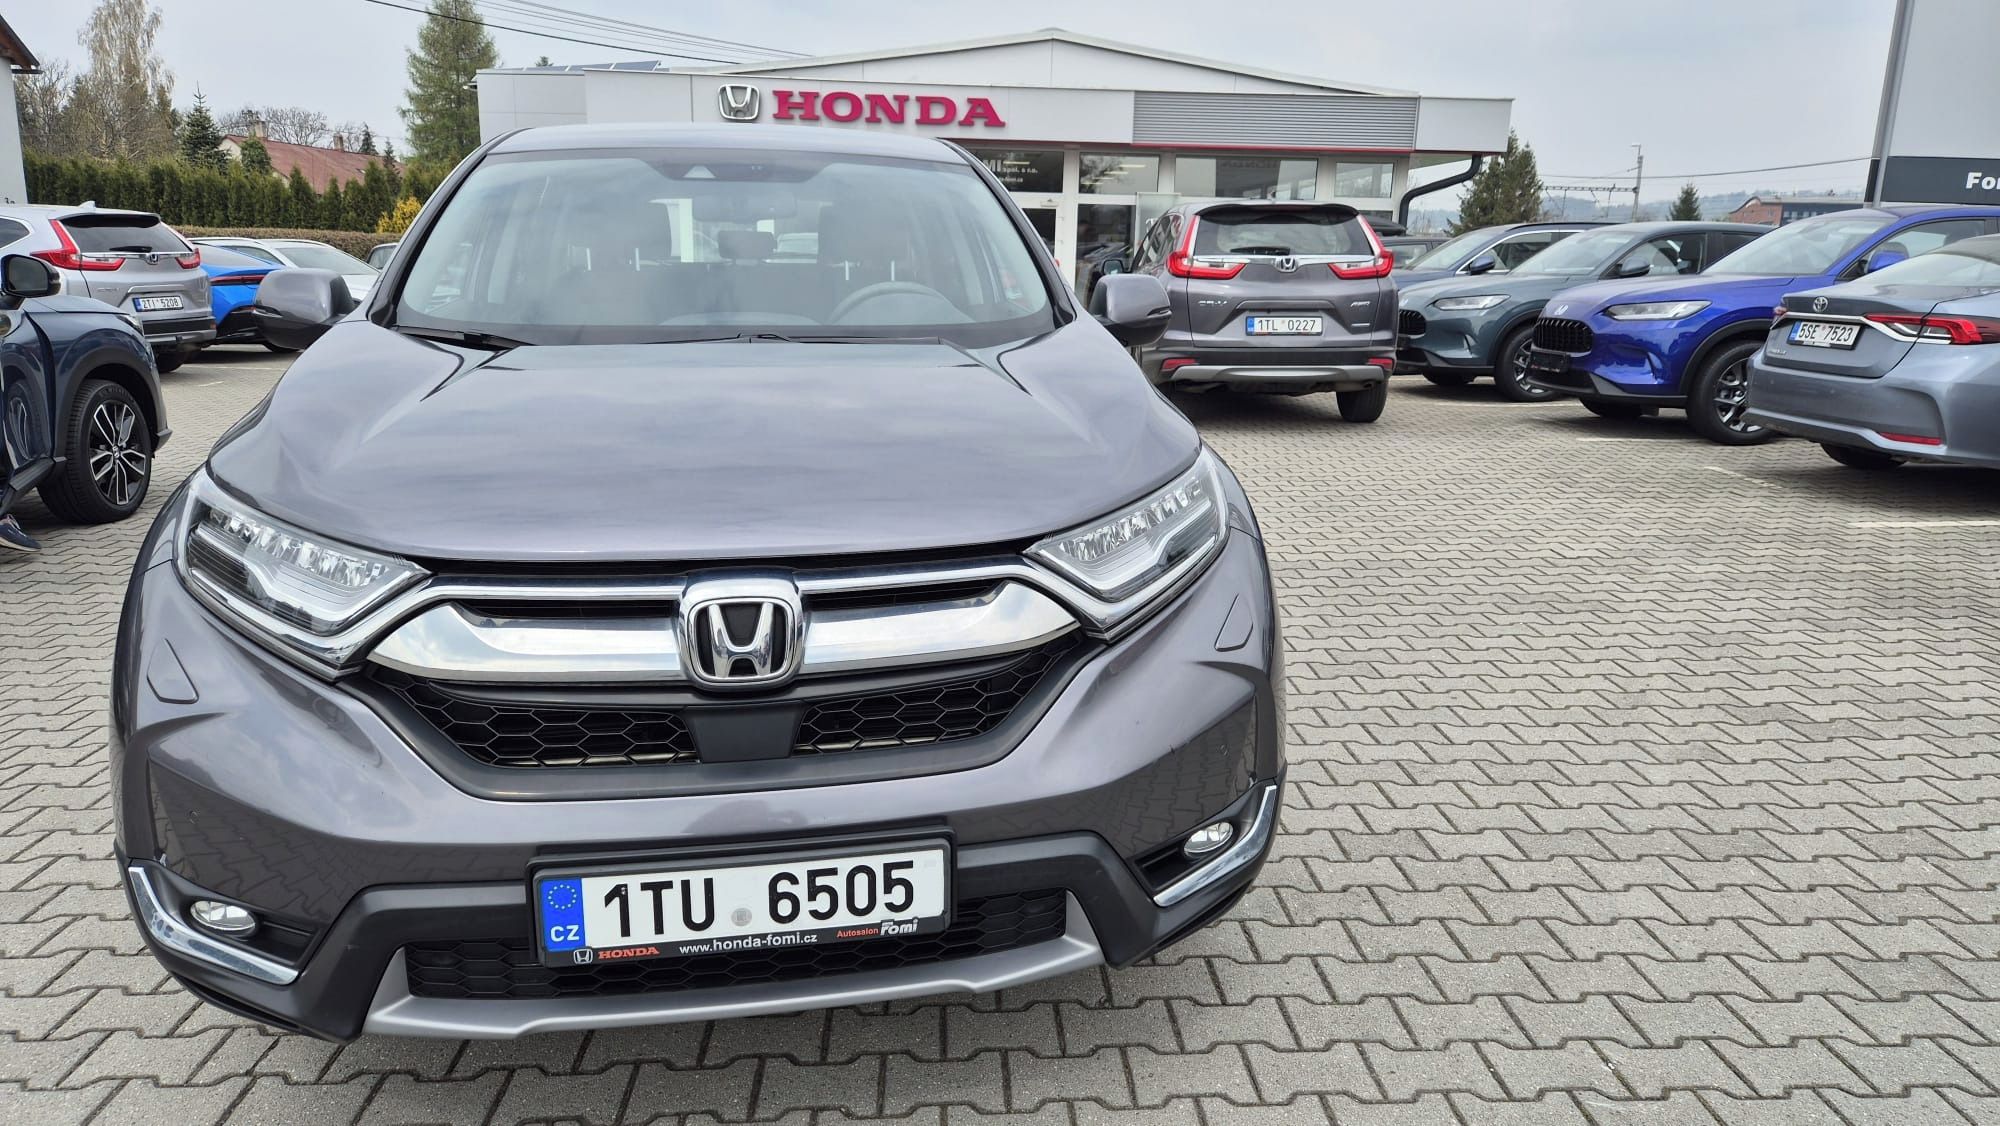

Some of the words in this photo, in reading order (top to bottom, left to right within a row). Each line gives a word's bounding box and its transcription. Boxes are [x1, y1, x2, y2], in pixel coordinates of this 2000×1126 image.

[772, 89, 1006, 127] HONDA
[1966, 172, 2000, 189] Fo
[1258, 320, 1278, 331] 1TL
[1287, 320, 1316, 331] 0227
[1799, 324, 1820, 339] 5SE
[1824, 326, 1853, 341] 7523
[604, 877, 716, 938] 1TU
[767, 860, 915, 925] 6505
[550, 923, 580, 943] CZ
[836, 927, 879, 938] Autosalon
[678, 931, 818, 956] www.honda-fomi.cz
[598, 946, 660, 959] HONDA
